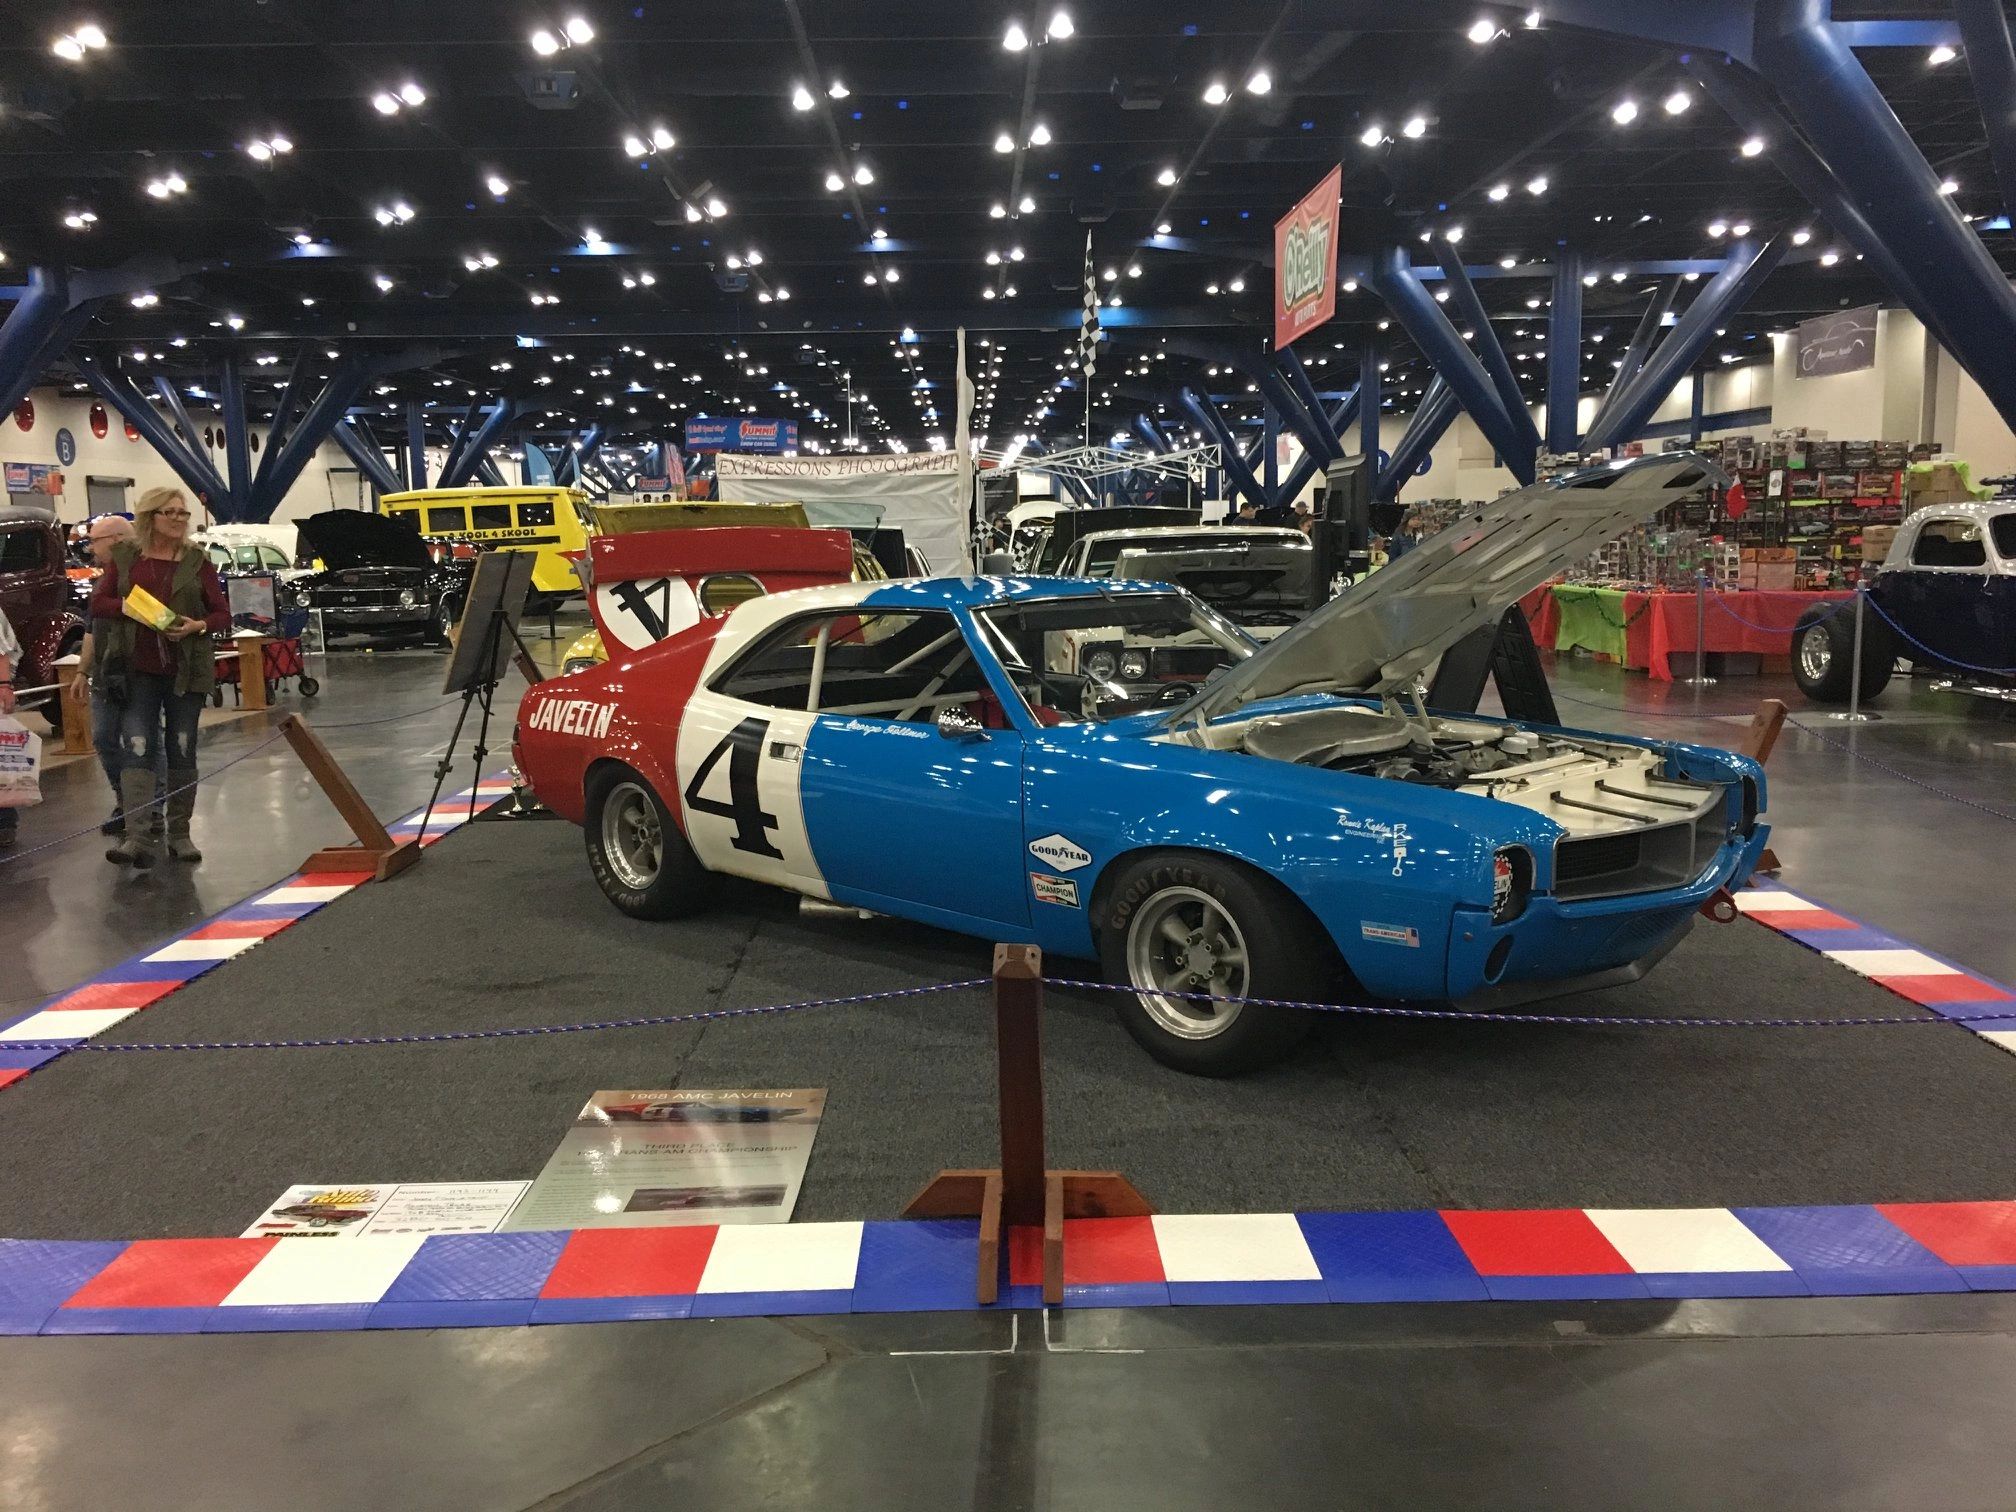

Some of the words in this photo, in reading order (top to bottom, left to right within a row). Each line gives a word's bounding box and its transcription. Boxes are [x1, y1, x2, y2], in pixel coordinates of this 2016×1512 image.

[62, 442, 70, 461] B
[718, 459, 832, 477] EXPRESSIONS
[460, 530, 488, 539] KOOL
[491, 530, 498, 538] 4
[501, 529, 536, 537] SKOOL
[529, 697, 617, 739] JAVELIN
[684, 716, 785, 860] 4
[1031, 844, 1089, 862] GOODYEAR
[1036, 883, 1074, 898] CHAMPION
[717, 1091, 793, 1099] JAVELIN
